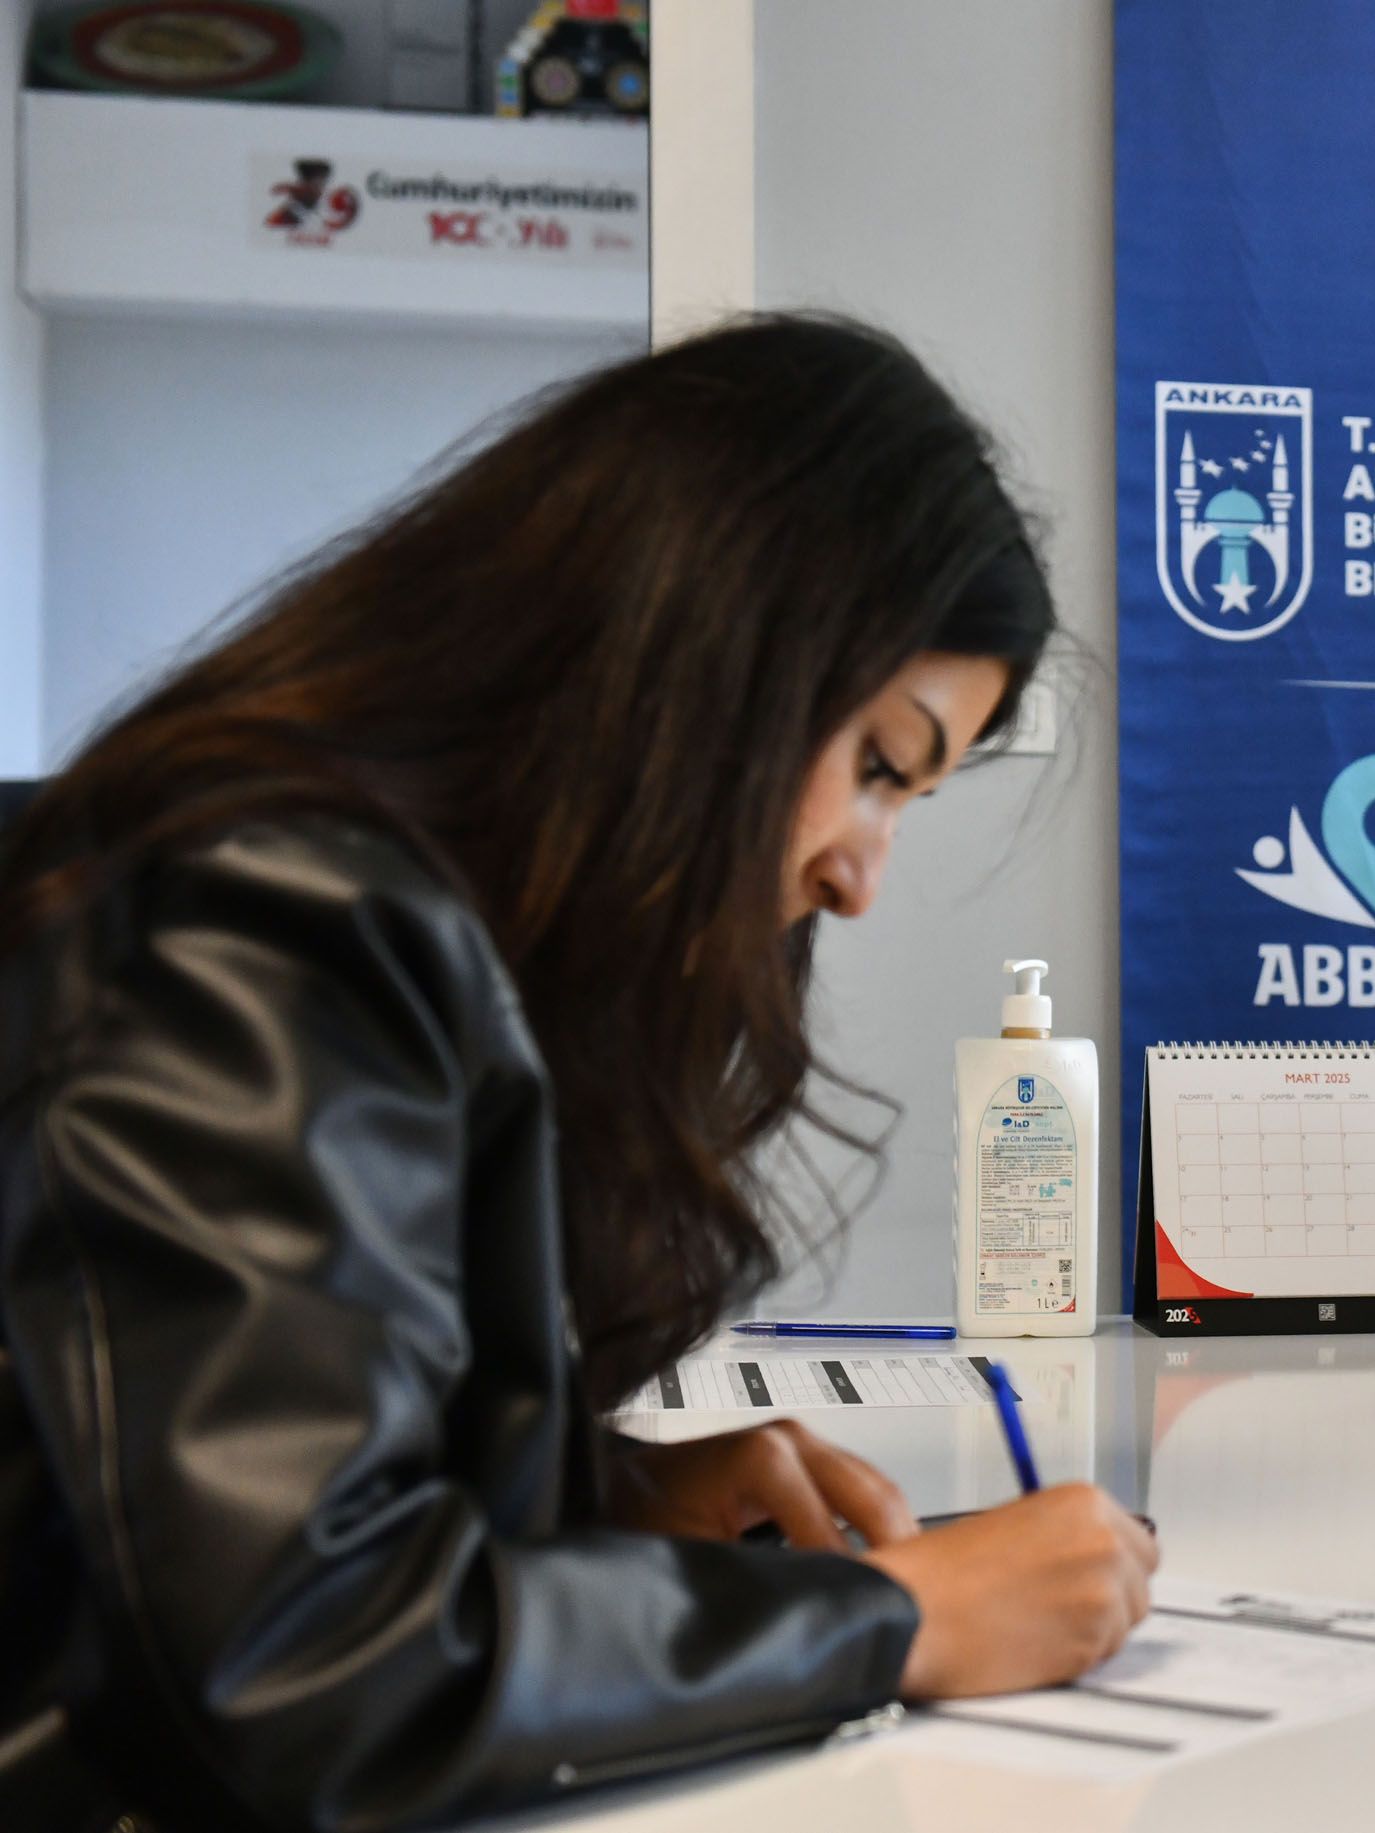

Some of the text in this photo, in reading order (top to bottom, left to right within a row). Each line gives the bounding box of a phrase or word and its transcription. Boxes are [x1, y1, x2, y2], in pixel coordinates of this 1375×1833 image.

[1165, 388, 1302, 408] ANKARA
[1285, 1073, 1351, 1084] MART 2025
